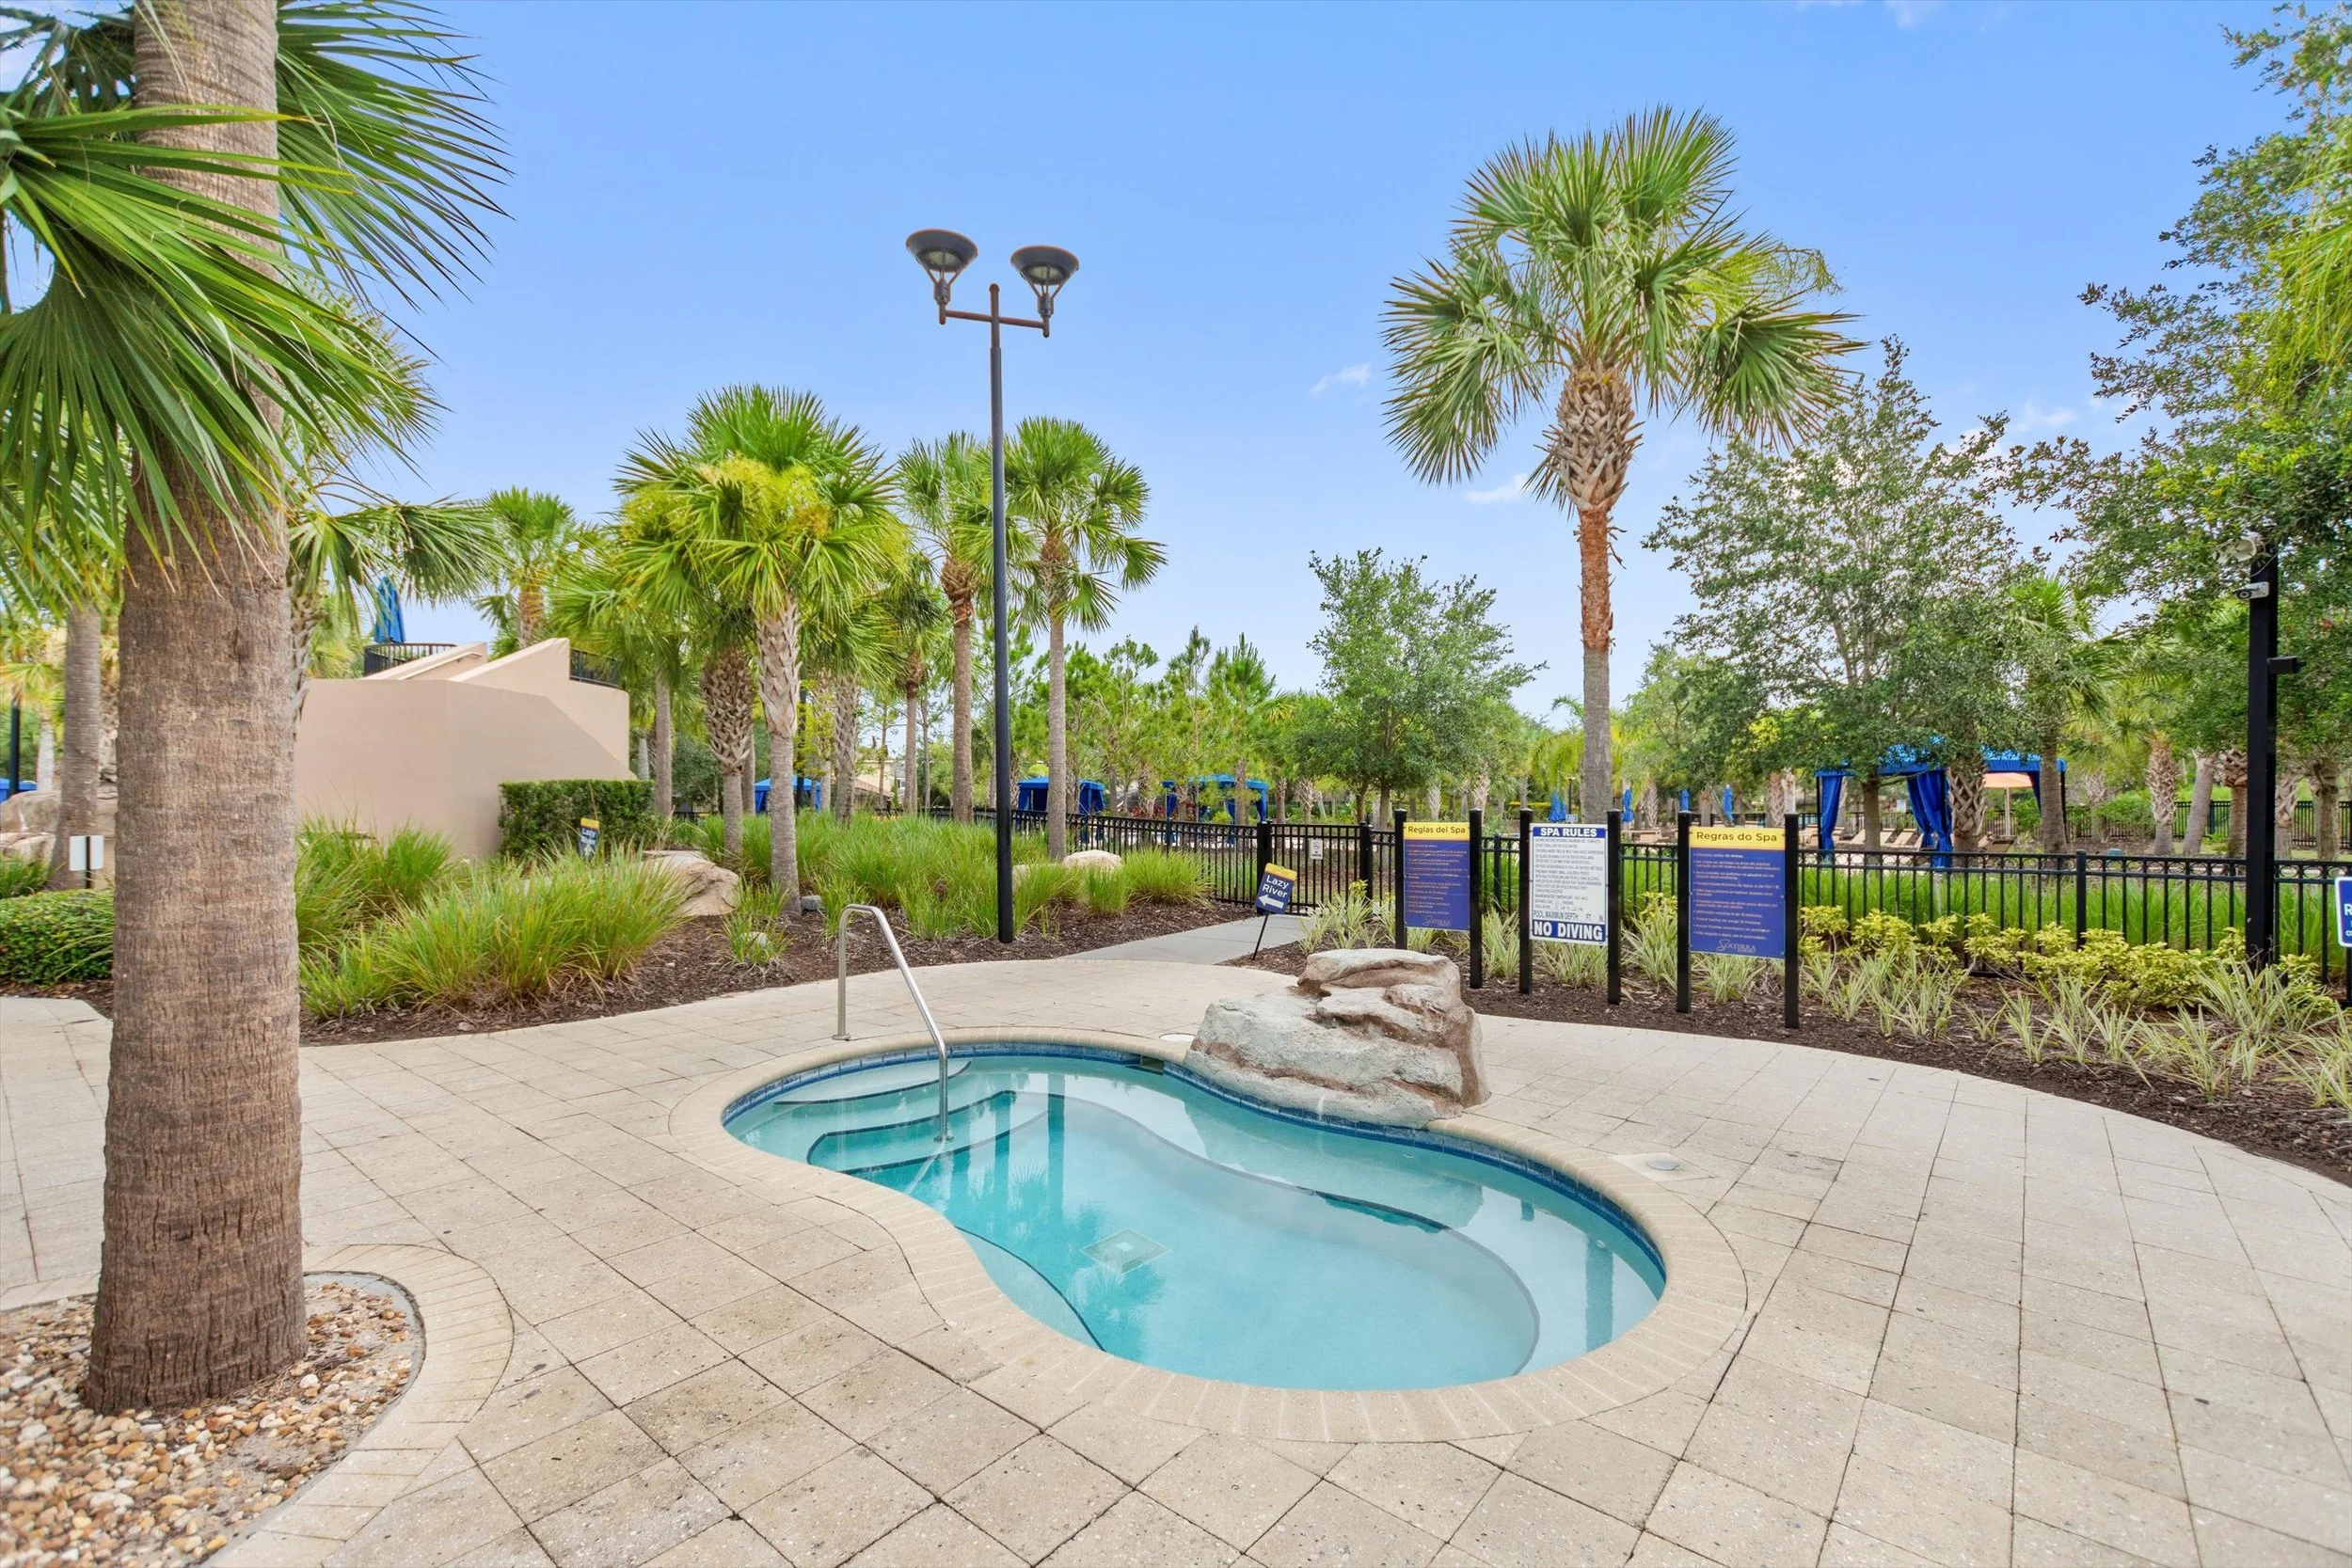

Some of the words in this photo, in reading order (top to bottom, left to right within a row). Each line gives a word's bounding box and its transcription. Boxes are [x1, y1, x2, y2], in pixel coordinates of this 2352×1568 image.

[1407, 826, 1434, 834] Reglas
[1540, 828, 1560, 836] SPA
[1563, 829, 1597, 837] RULES
[1696, 832, 1734, 842] Regras
[1738, 832, 1752, 841] do
[1756, 832, 1777, 843] Spa
[1266, 875, 1289, 890] Lazy
[1262, 884, 1288, 897] River
[1534, 921, 1552, 936] NO
[1557, 923, 1603, 941] DIVING
